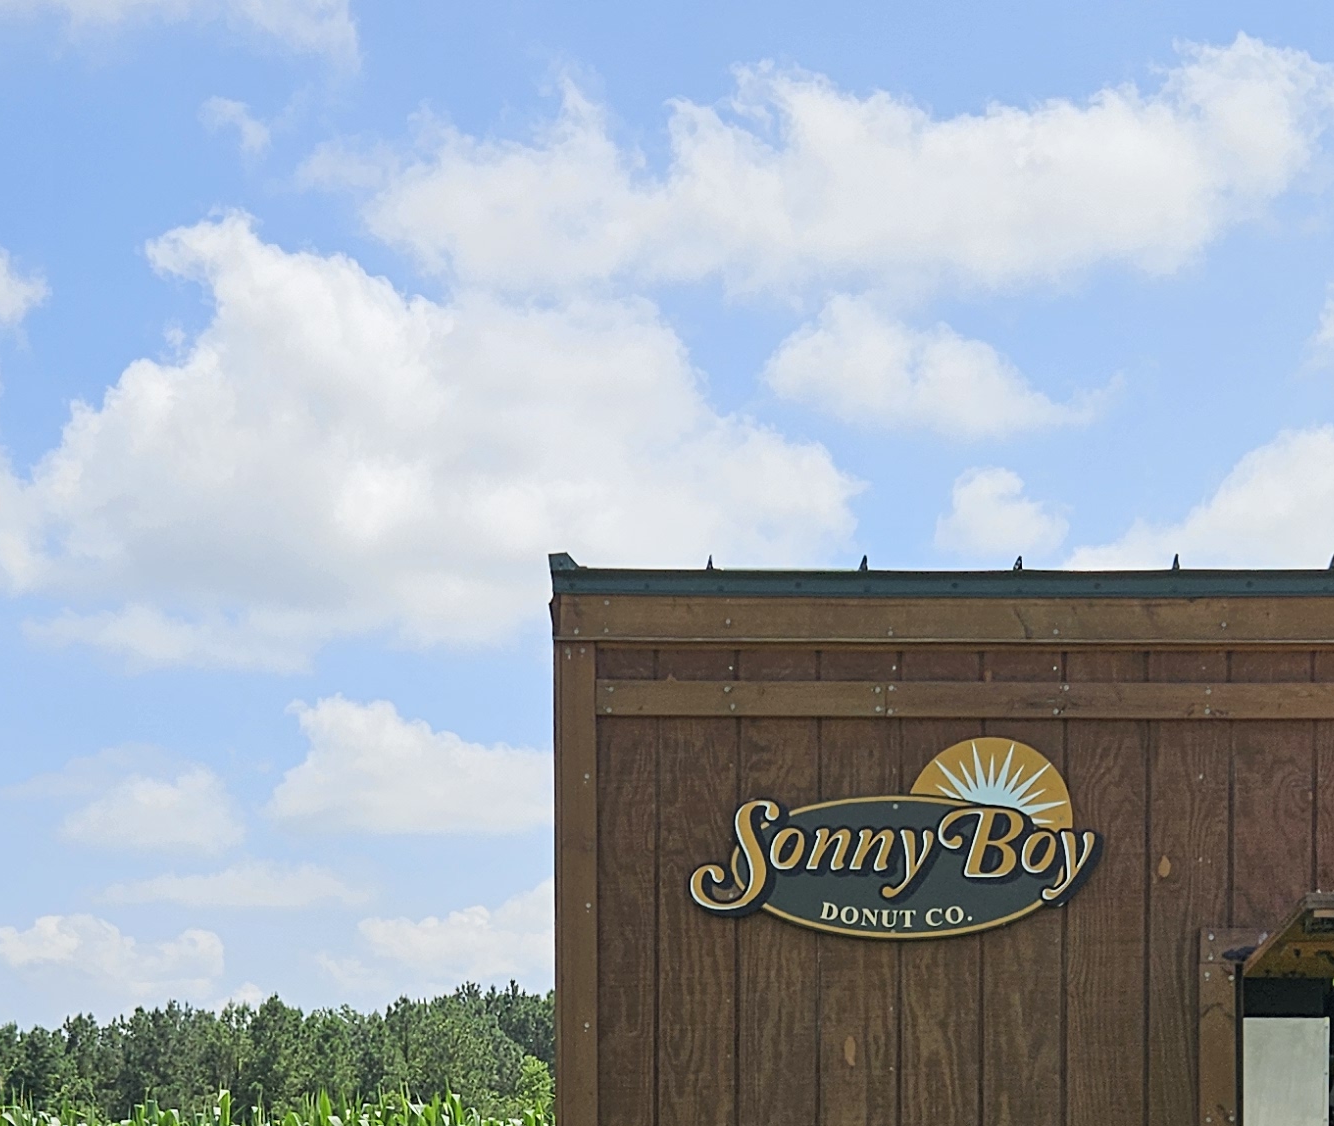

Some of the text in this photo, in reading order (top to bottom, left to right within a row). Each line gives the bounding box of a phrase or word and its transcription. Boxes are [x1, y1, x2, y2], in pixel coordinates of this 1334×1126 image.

[690, 801, 1094, 910] Sonny Boy
[820, 902, 972, 928] DONUT CO.
